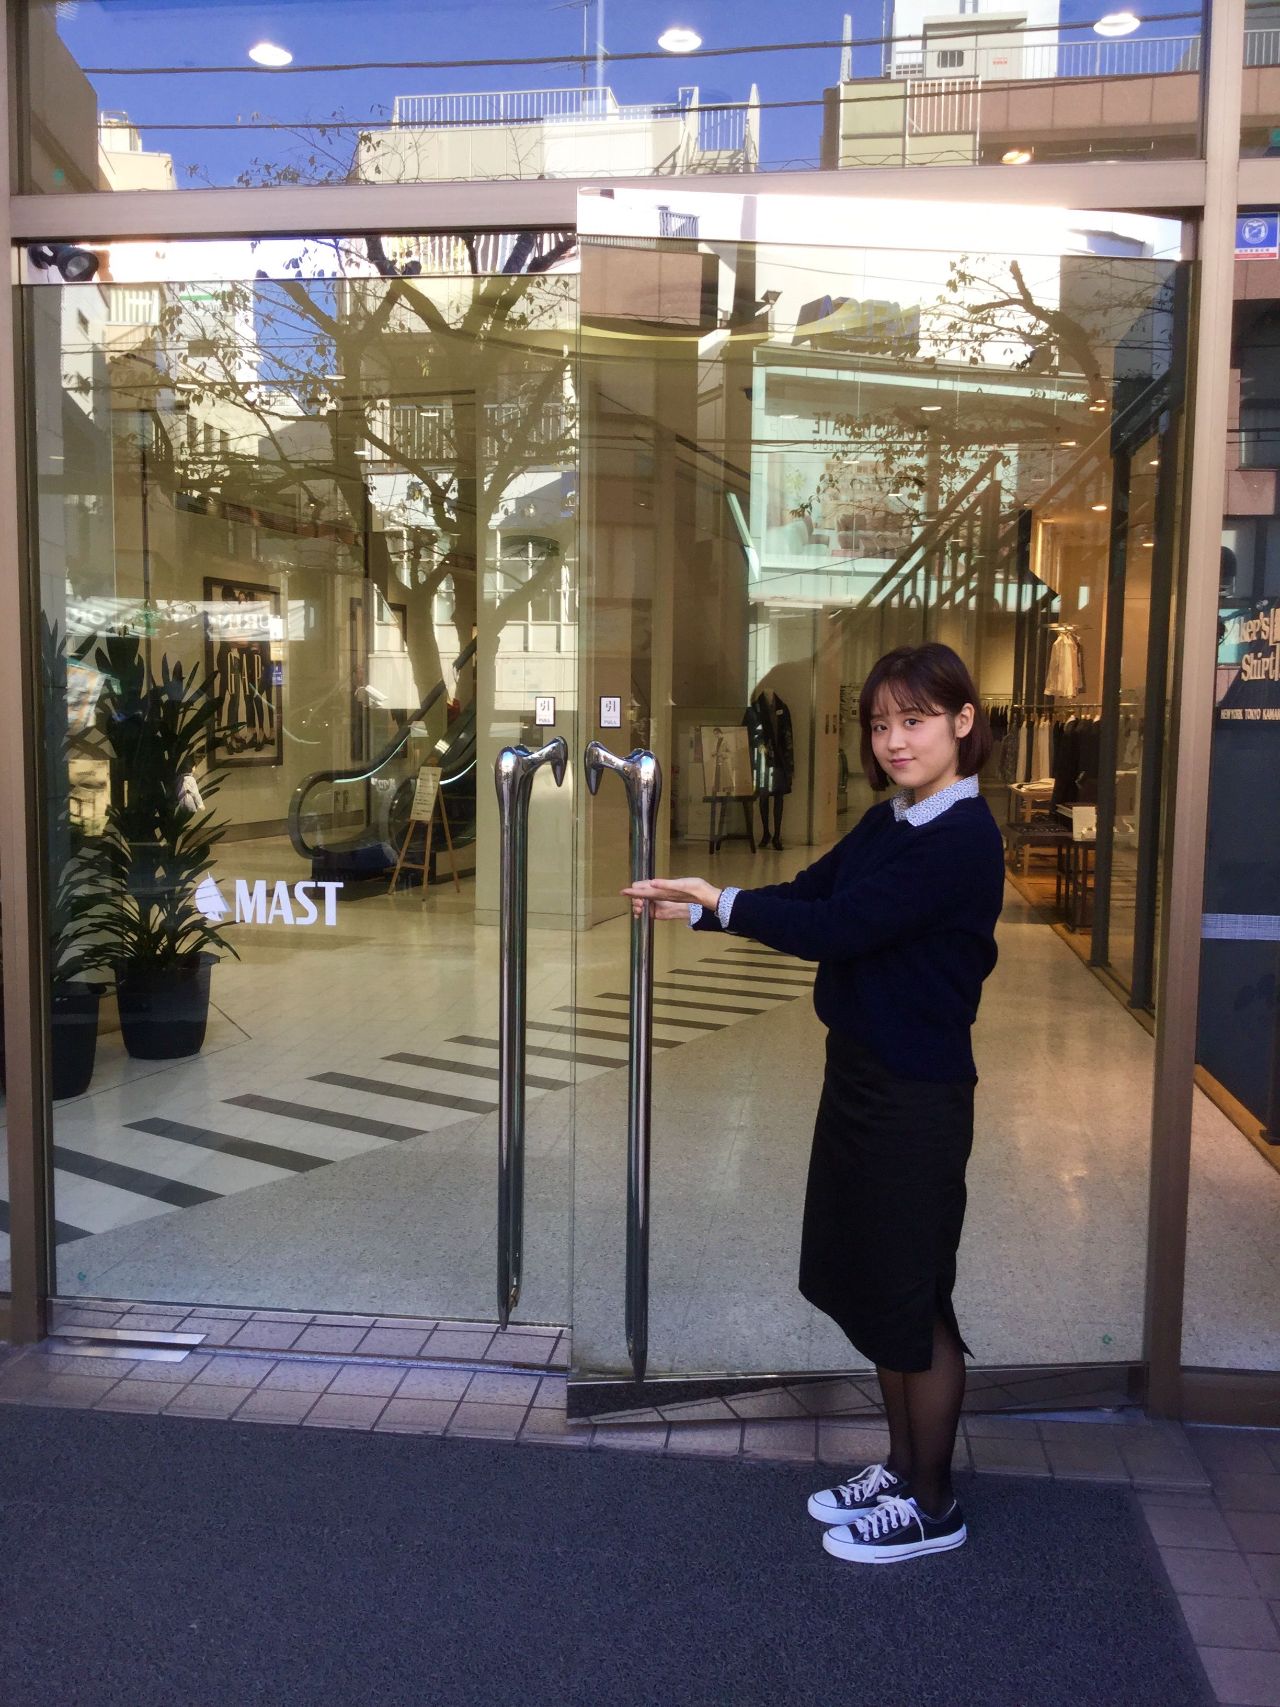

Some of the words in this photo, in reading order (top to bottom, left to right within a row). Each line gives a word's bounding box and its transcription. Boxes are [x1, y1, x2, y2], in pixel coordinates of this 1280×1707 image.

[227, 652, 262, 695] GAP
[540, 699, 550, 712] 引
[606, 700, 616, 713] 引
[235, 879, 344, 926] MAST
